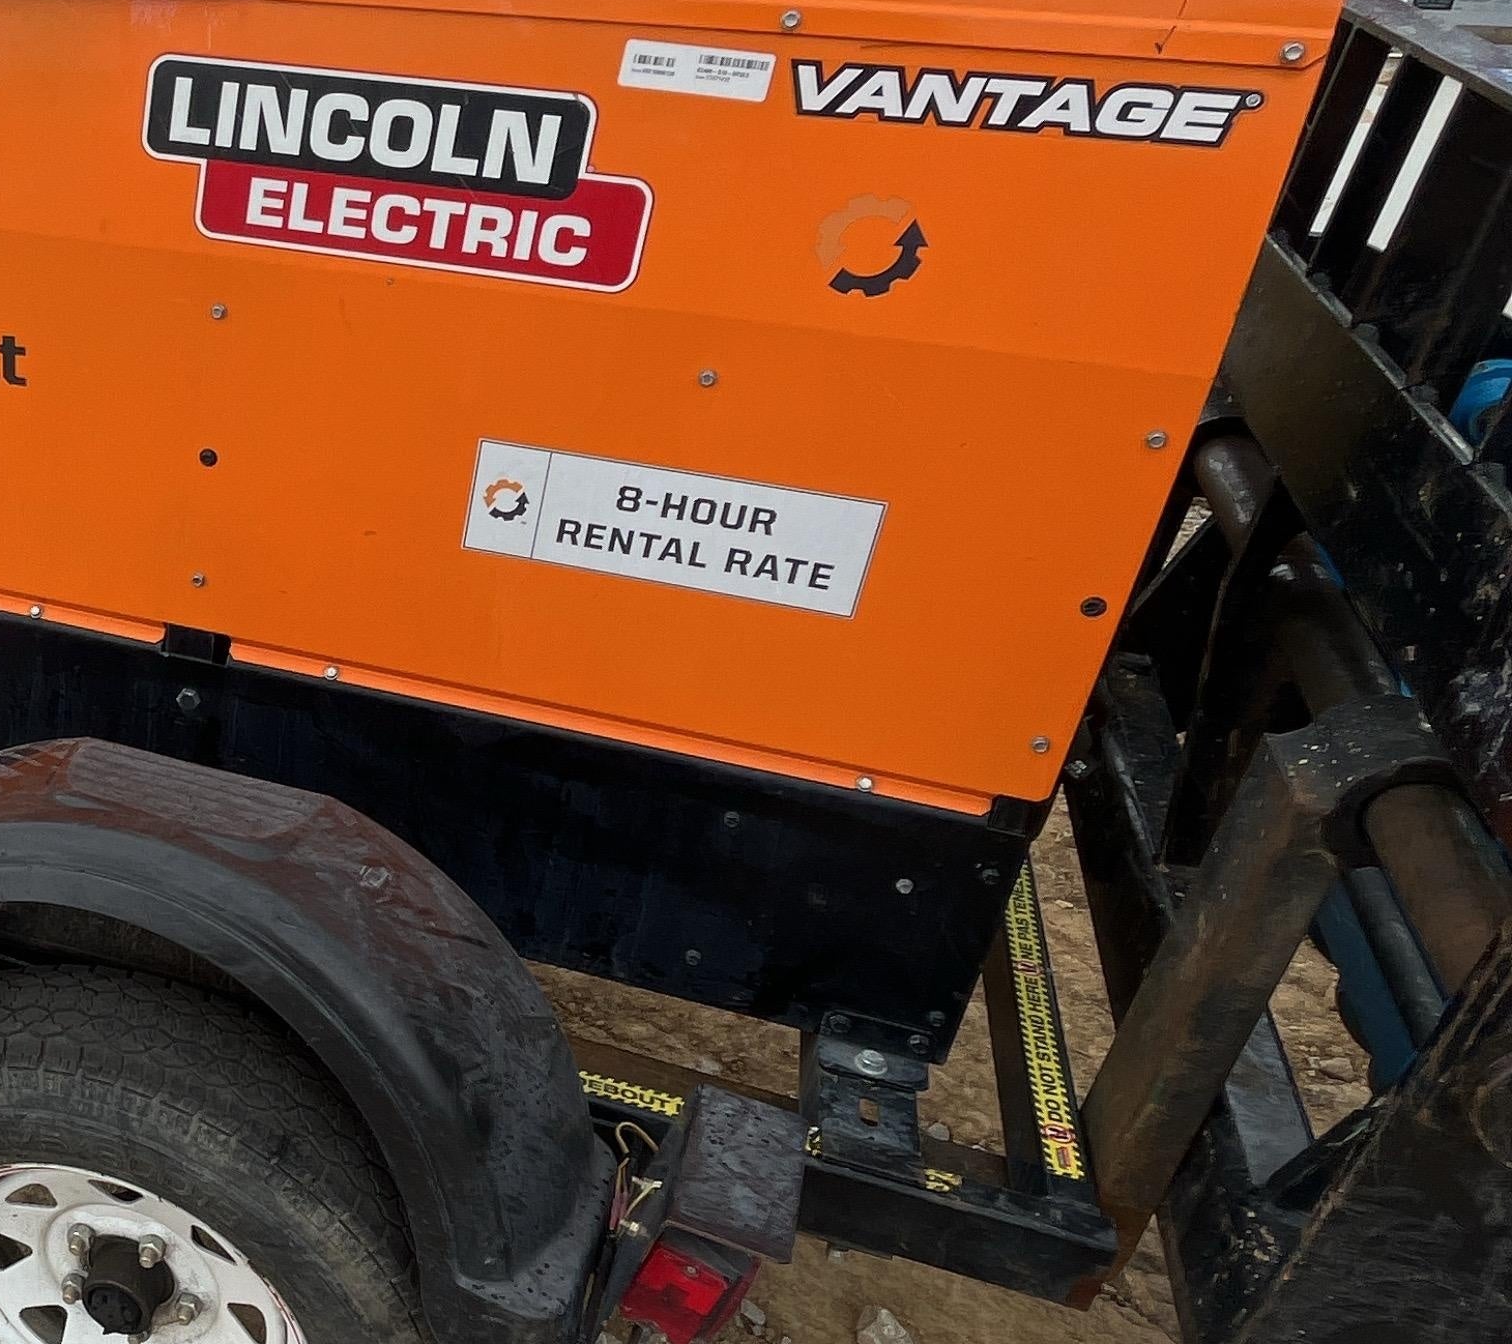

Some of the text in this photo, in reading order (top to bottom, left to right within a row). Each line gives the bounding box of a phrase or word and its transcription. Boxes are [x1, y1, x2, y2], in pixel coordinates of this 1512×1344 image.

[796, 64, 1242, 142] VANTAGE
[168, 76, 563, 185] LINCOLN
[245, 177, 592, 267] ELECTRIC
[616, 485, 778, 536] 8-HOUR
[556, 518, 835, 591] RENTAL RATE
[1016, 917, 1031, 940] PAS
[1023, 976, 1044, 1014] HERE
[1027, 1015, 1052, 1063] STAND
[583, 1078, 670, 1109] EBOUT
[1038, 1063, 1059, 1097] NOT
[1046, 1098, 1064, 1124] DO
